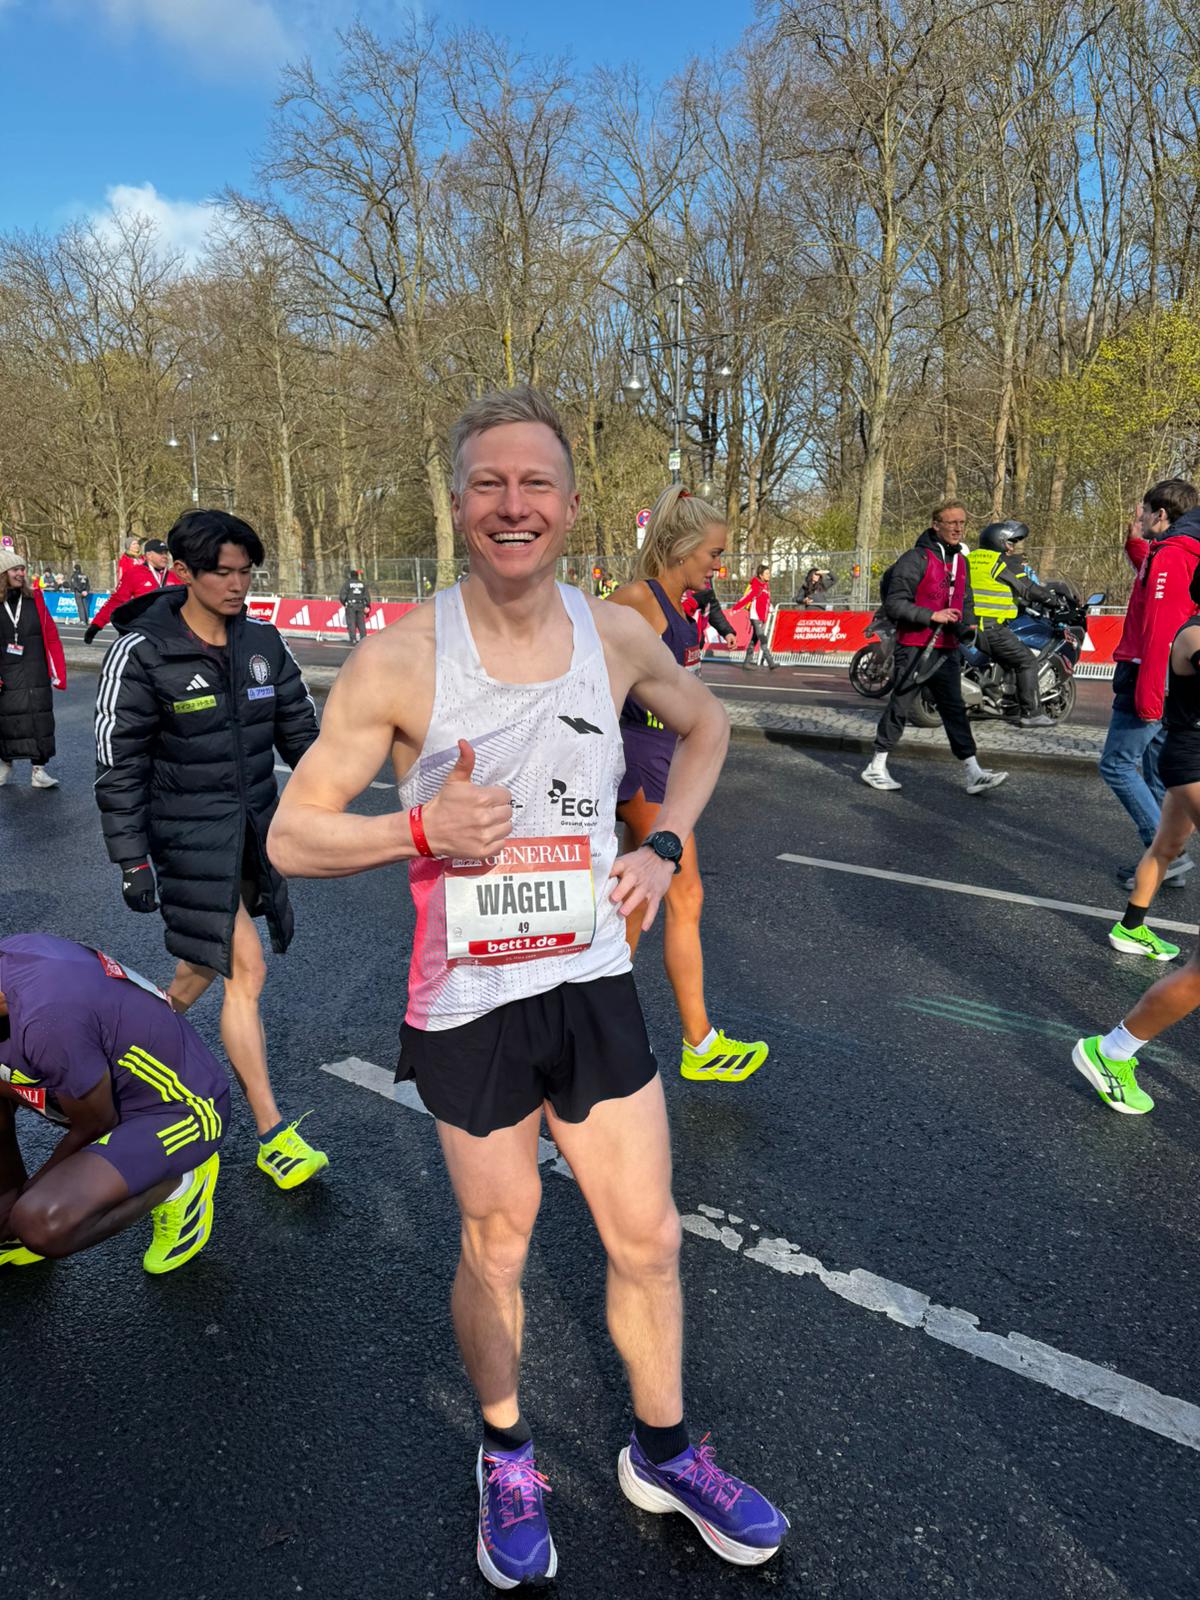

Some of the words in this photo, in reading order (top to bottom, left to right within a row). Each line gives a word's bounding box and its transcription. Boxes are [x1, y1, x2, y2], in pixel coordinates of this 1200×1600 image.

[1154, 572, 1168, 599] TEAM
[476, 875, 567, 916] WÄGELI
[518, 922, 530, 933] 49
[487, 936, 557, 952] bett1.de
